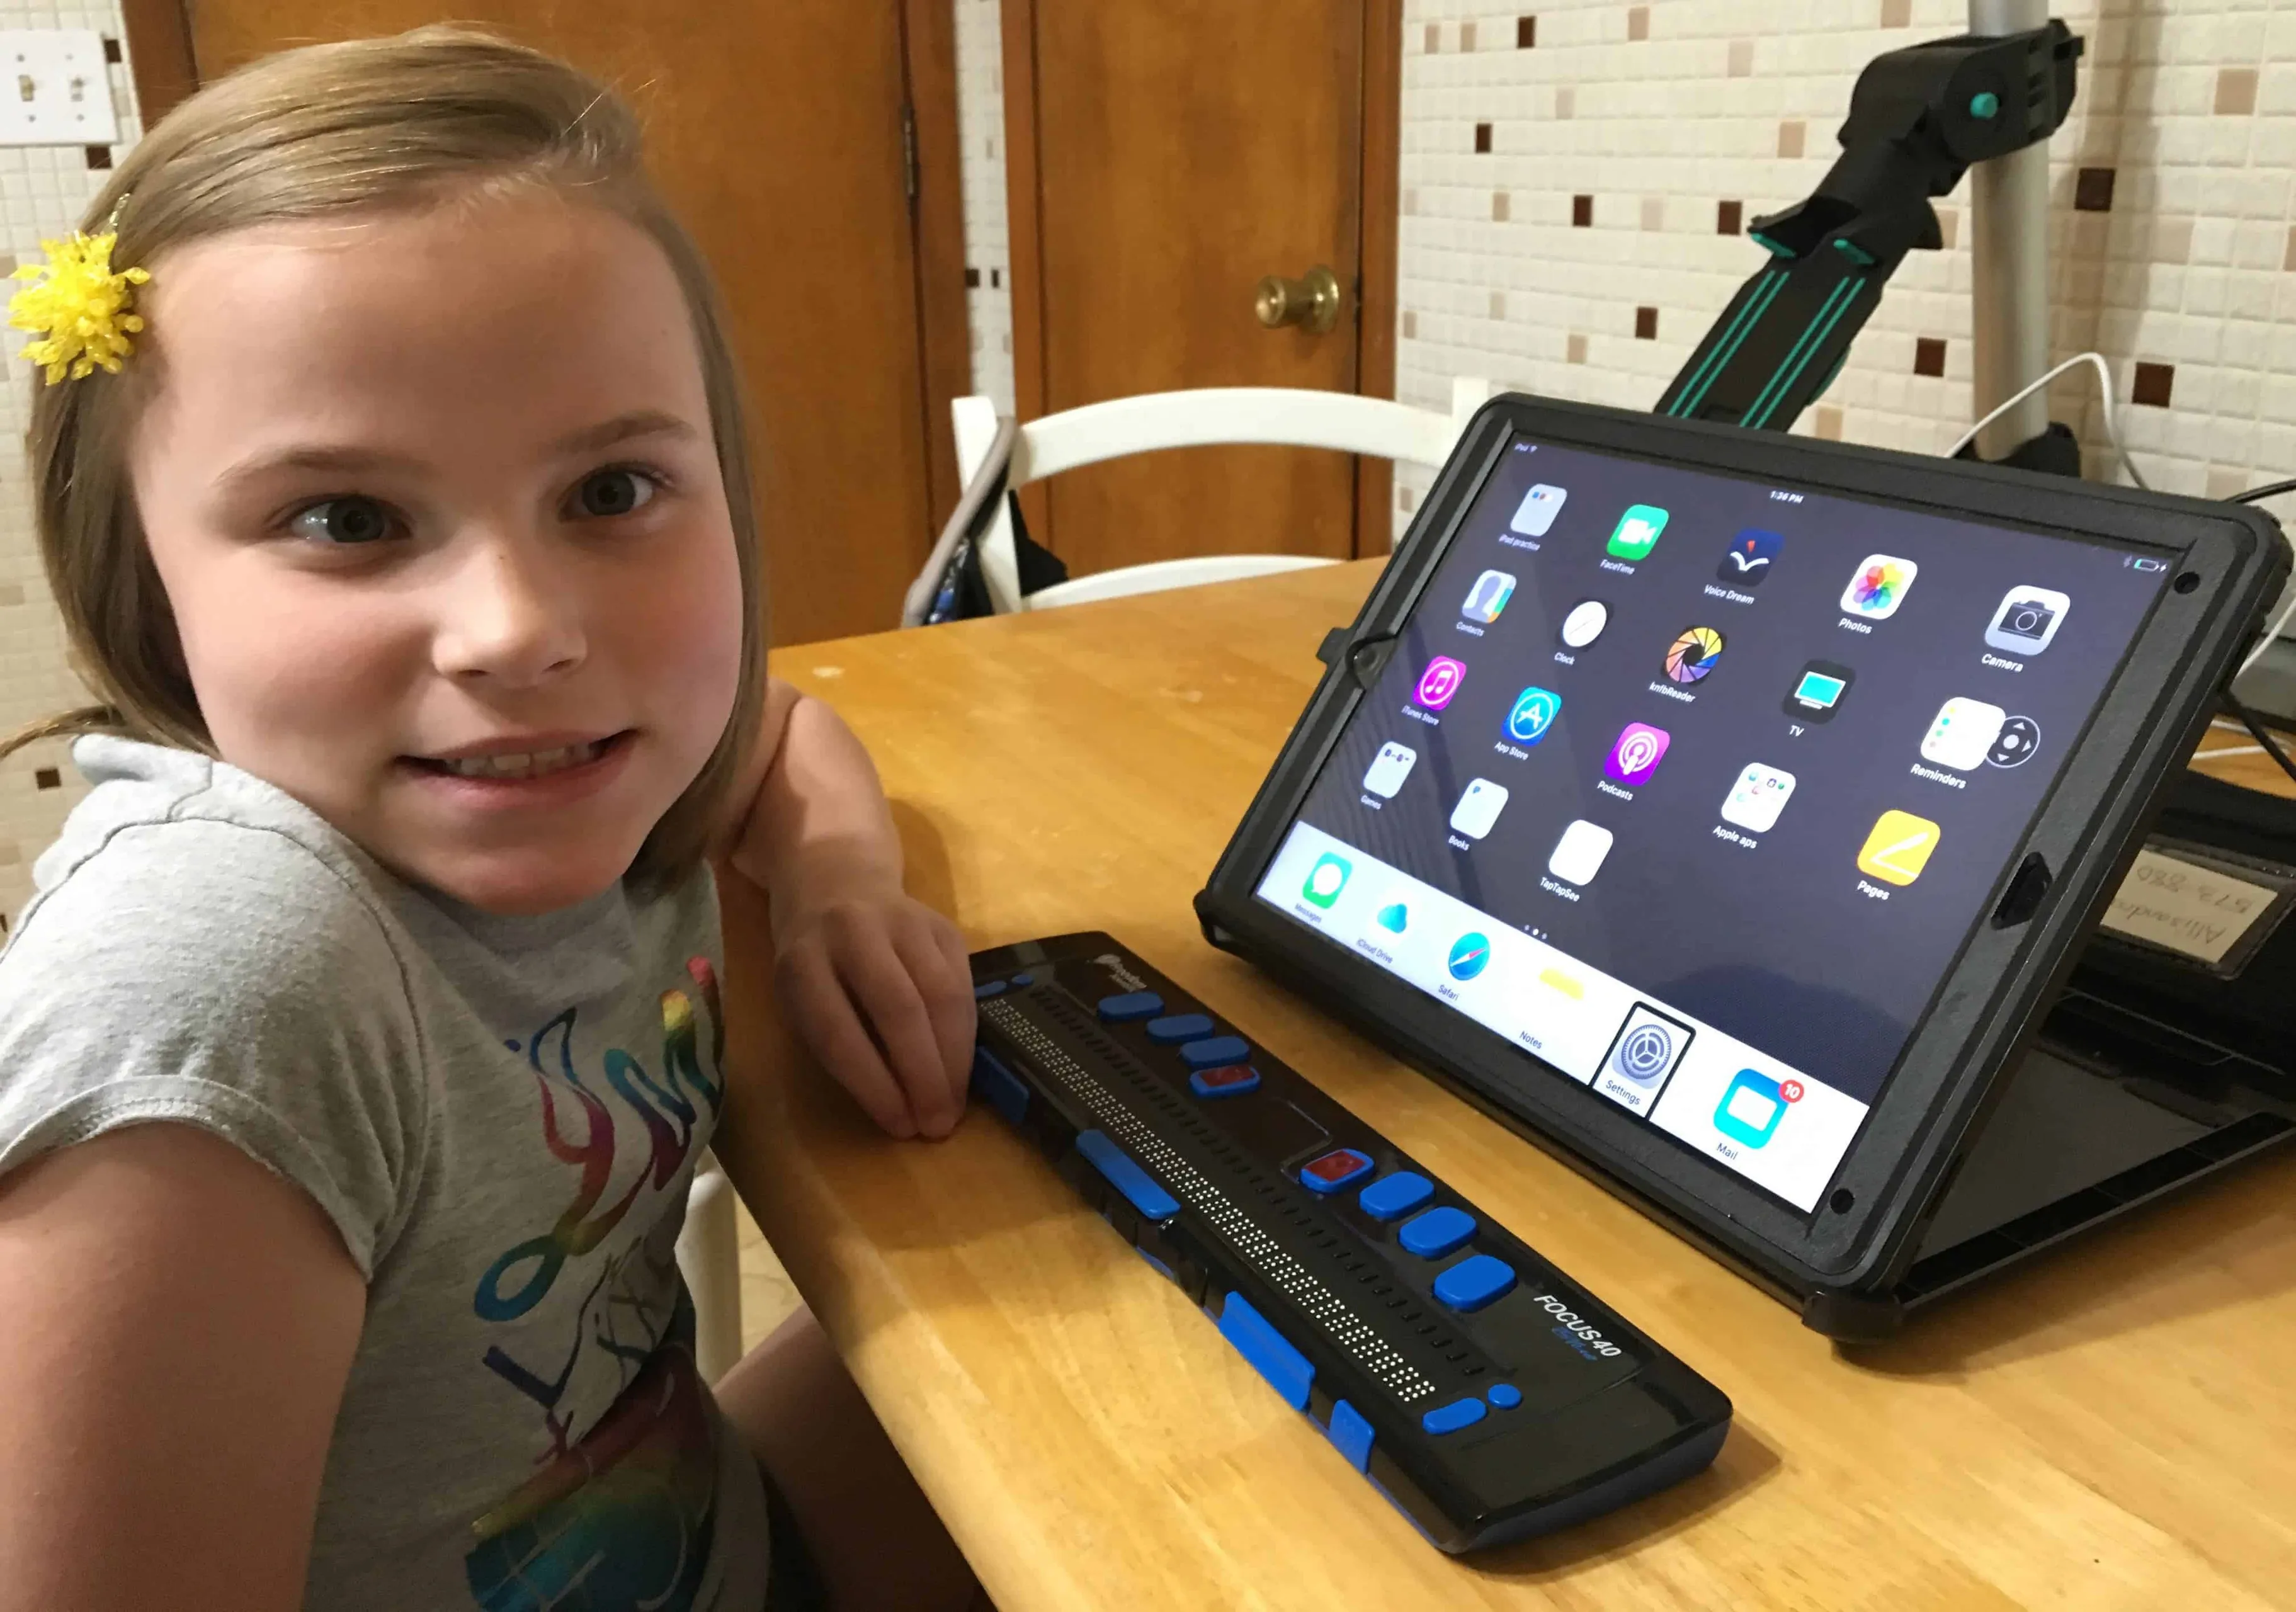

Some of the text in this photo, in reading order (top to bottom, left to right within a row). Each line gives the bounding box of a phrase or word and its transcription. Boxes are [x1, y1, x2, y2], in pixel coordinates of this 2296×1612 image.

[1788, 493, 1804, 504] PM
[1513, 538, 1540, 552] practice
[1600, 559, 1635, 575] FaceTime
[1704, 584, 1754, 604] Voice Dream
[1456, 621, 1484, 637] Contacts
[1838, 617, 1872, 634] Photos
[1554, 651, 1575, 665] Clock
[1981, 653, 2023, 673] Camera
[1649, 681, 1696, 703] knfbReader
[1401, 705, 1439, 725] iTunes Store
[1789, 725, 1804, 737] TV
[1494, 741, 1528, 761] App Store
[1911, 763, 1967, 789] Reminders
[1597, 780, 1634, 801] Podcasts
[1360, 795, 1382, 810] Games
[1448, 835, 1470, 851] Books
[1713, 825, 1758, 849] Apple aps
[1540, 877, 1580, 902] TapTapSee
[1856, 880, 1890, 901] Pages
[1294, 902, 1322, 923] Messages
[1356, 938, 1394, 964] iCloud Drive
[1438, 984, 1459, 1001] Safari
[1519, 1030, 1543, 1050] Notes
[1605, 1079, 1641, 1106] Settings
[1784, 1082, 1800, 1099] 10
[1715, 1142, 1739, 1161] Mail
